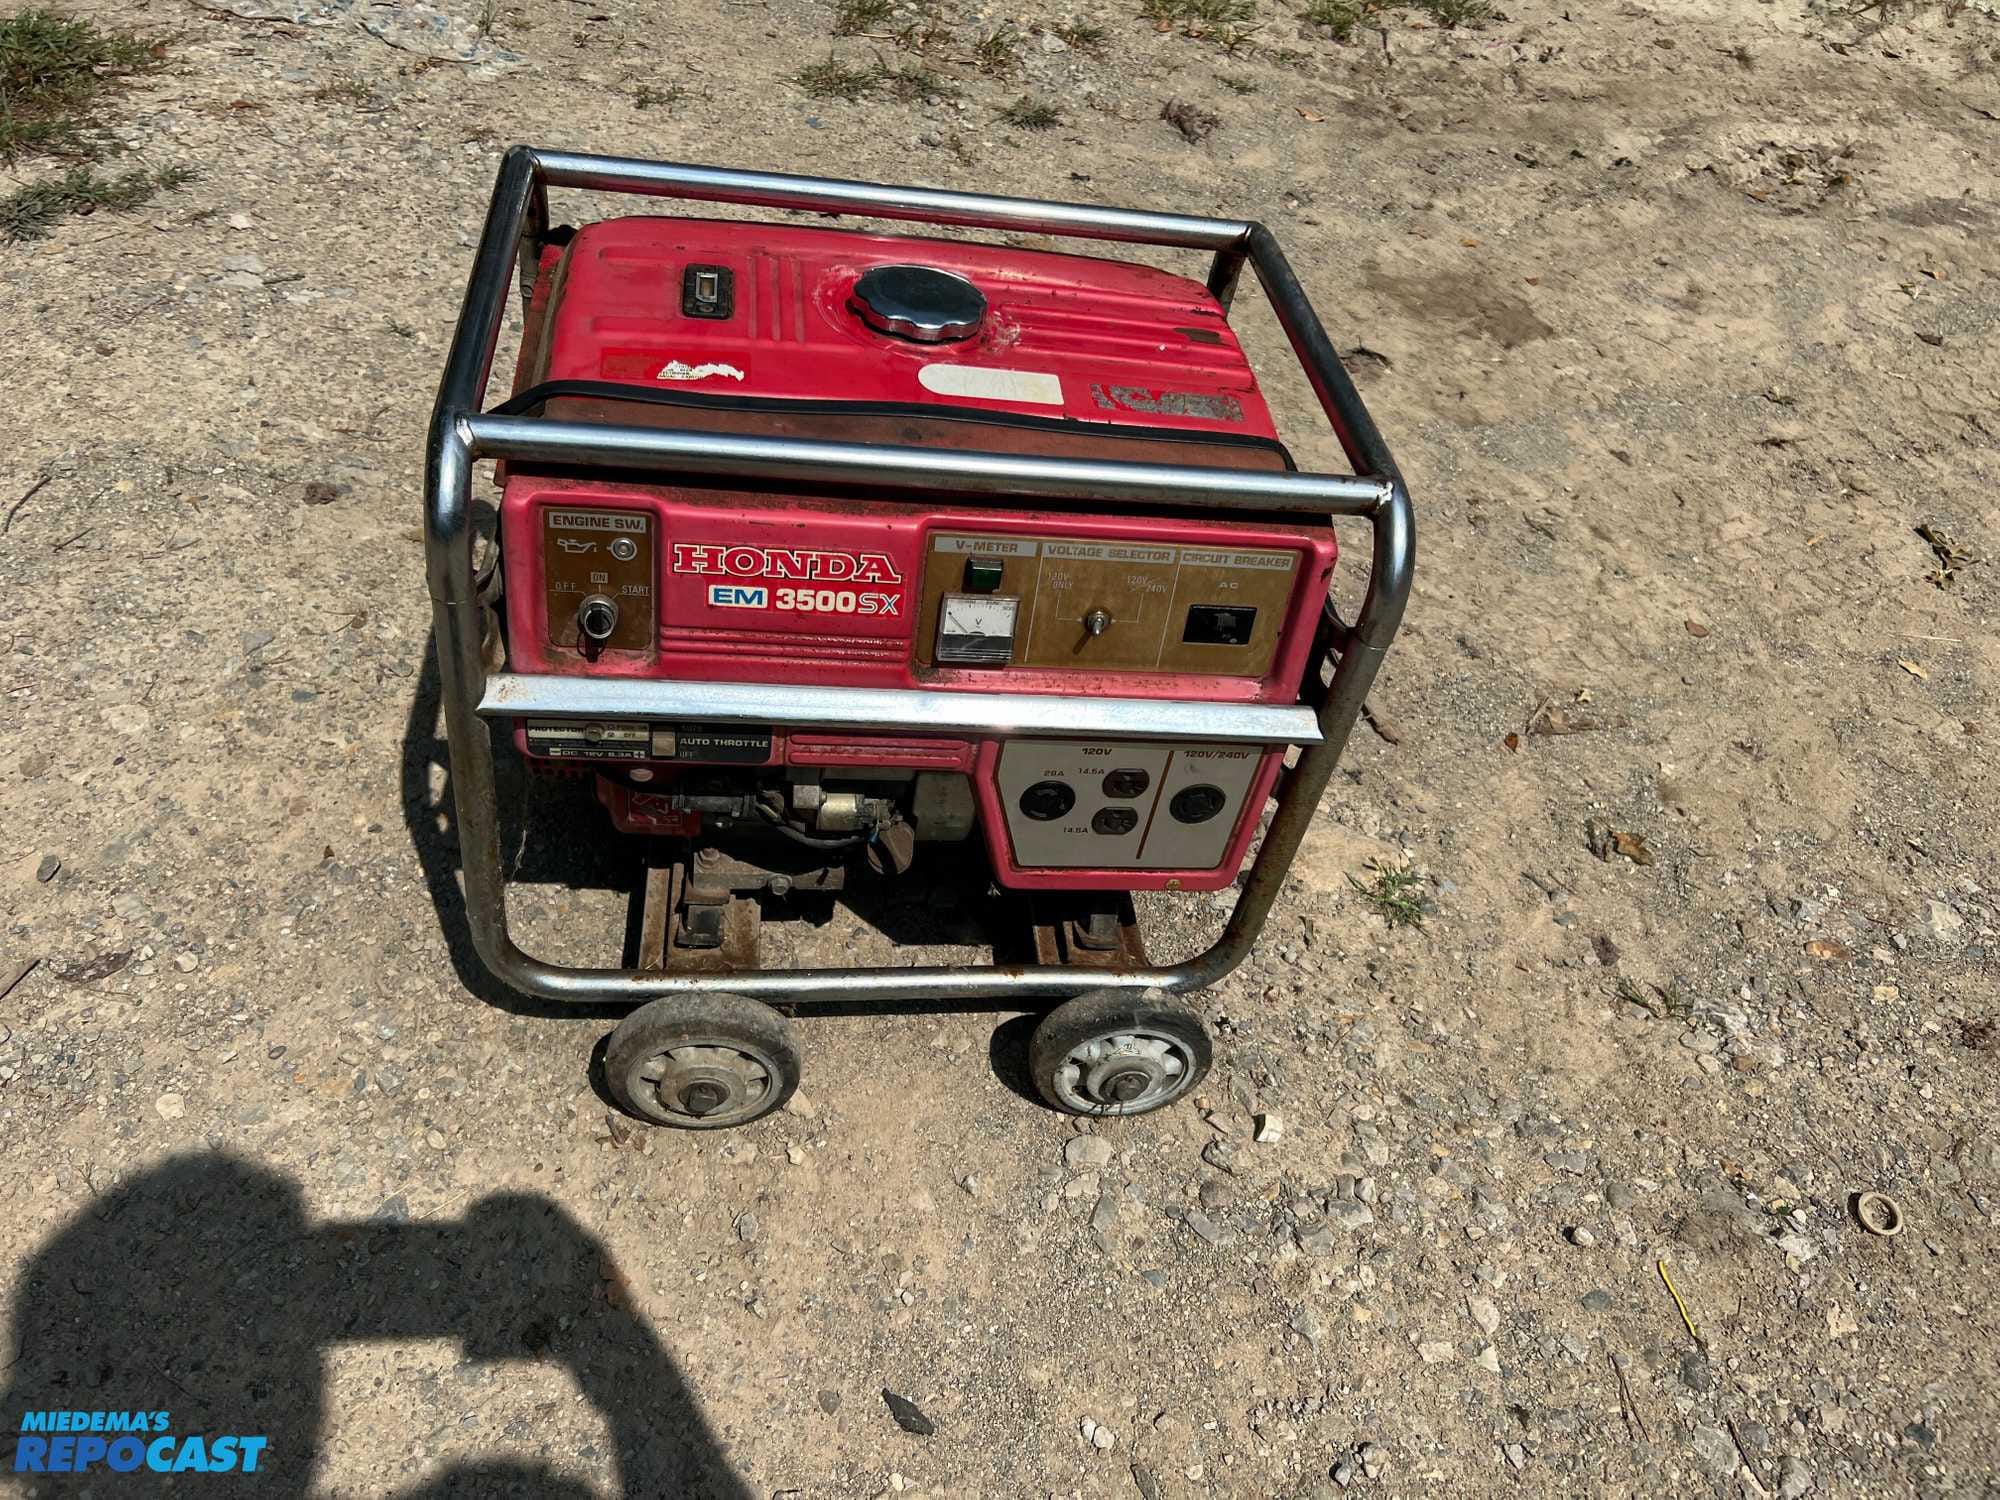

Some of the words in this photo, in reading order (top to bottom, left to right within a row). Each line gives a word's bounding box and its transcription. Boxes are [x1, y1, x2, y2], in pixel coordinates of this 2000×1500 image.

[553, 515, 611, 528] ENGINE
[615, 520, 644, 531] SW.
[955, 540, 1018, 553] V-METER
[1048, 545, 1103, 557] VOLTAGE
[1108, 549, 1170, 561] SELECTOR
[673, 543, 902, 584] HONDA
[1182, 552, 1230, 564] CIRCUIT
[1234, 556, 1291, 568] BREAKER
[622, 585, 649, 594] START
[712, 587, 763, 605] EM
[714, 739, 769, 748] THROTTLE
[1081, 747, 1113, 756] 120V
[1184, 750, 1249, 760] 120V/240V
